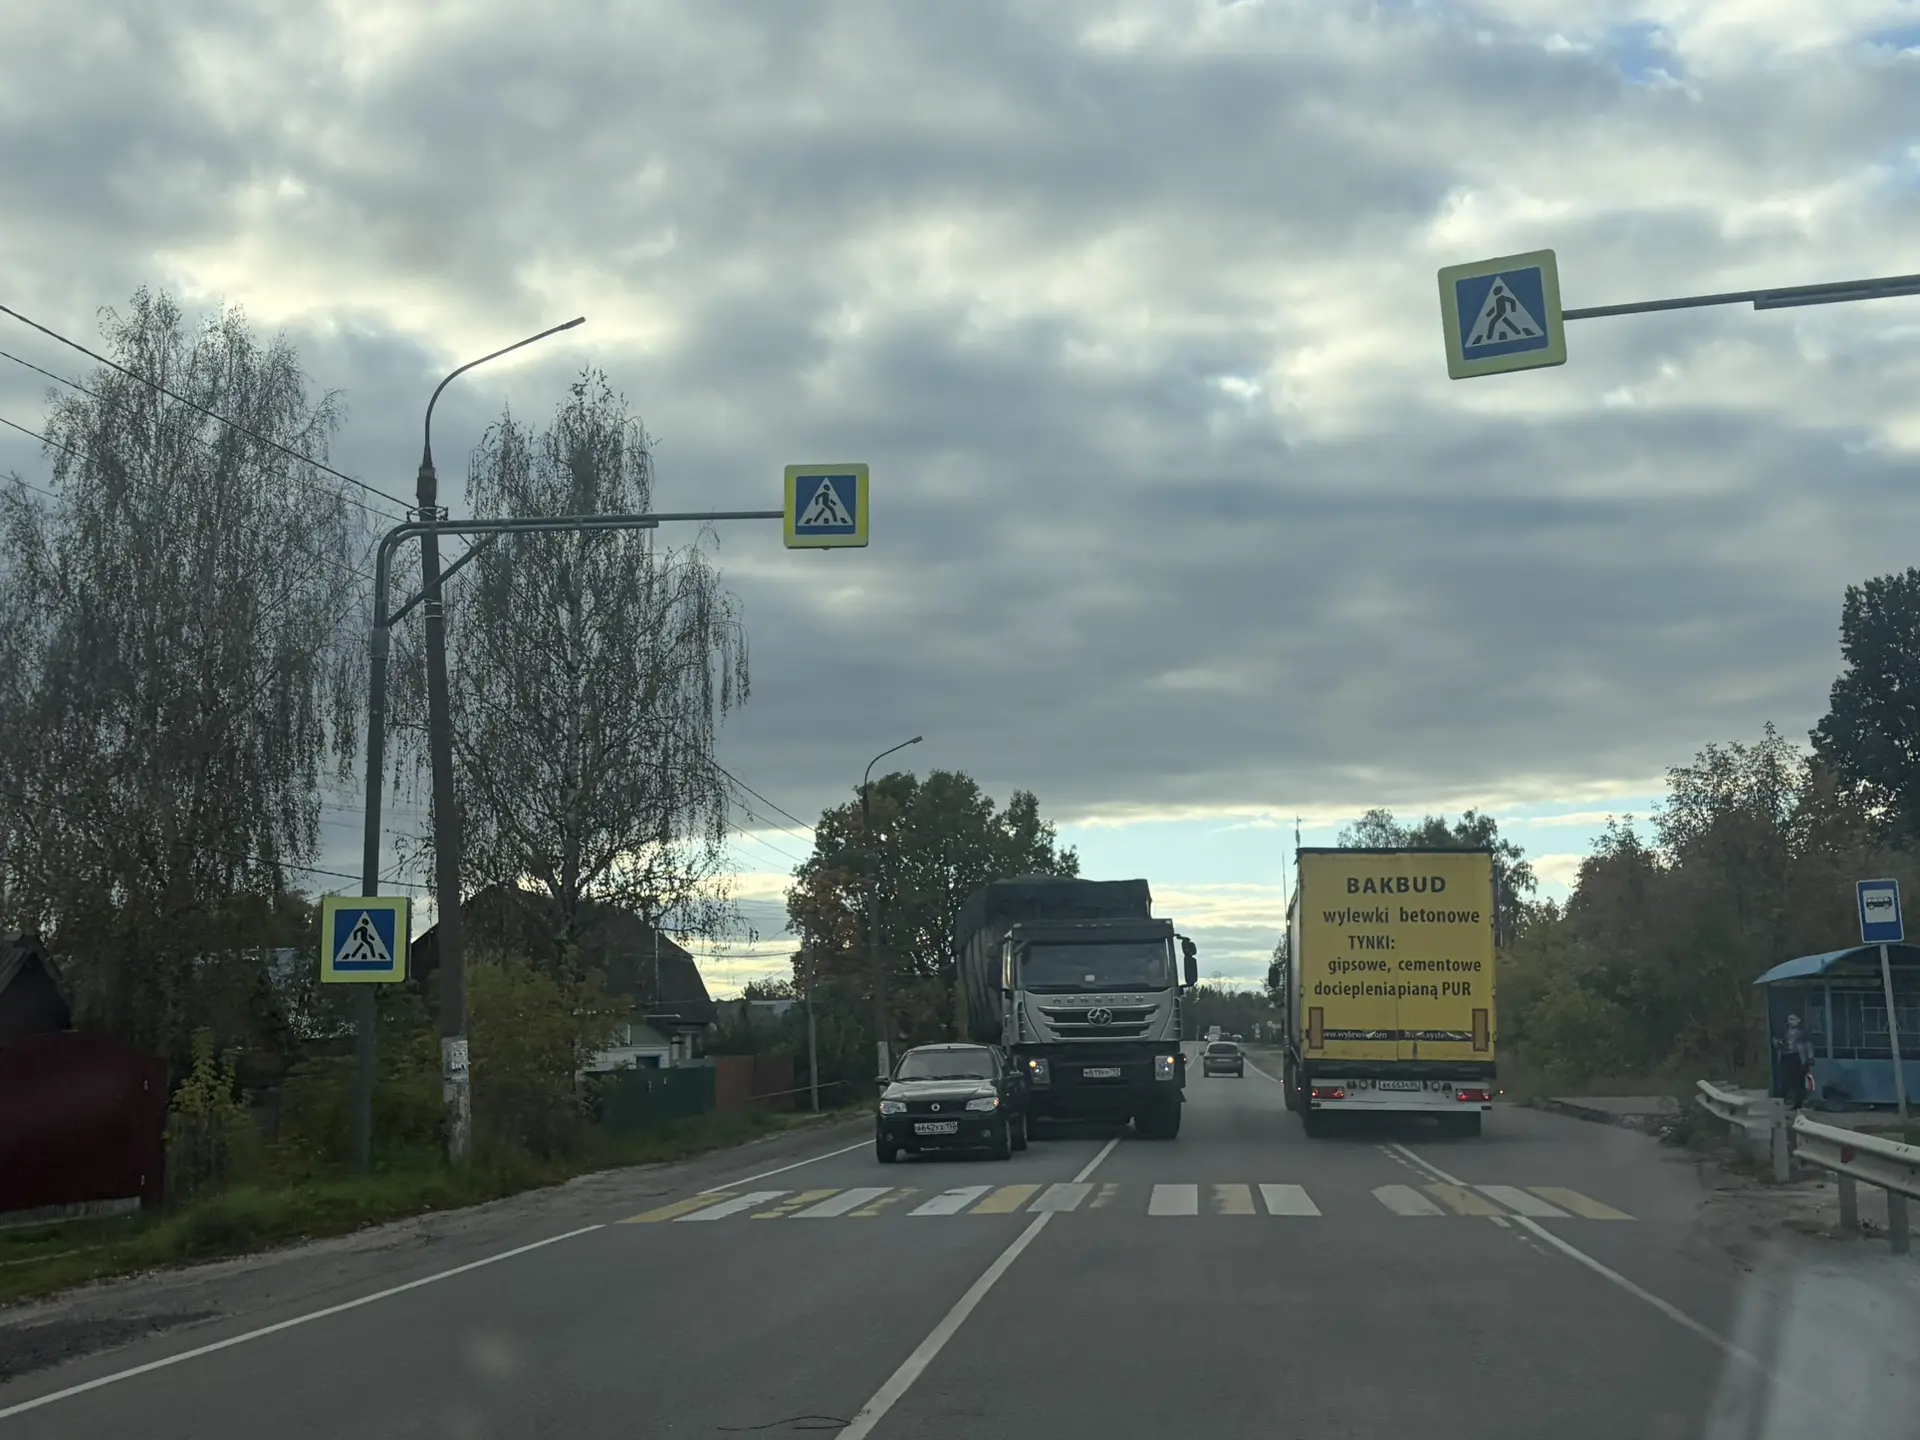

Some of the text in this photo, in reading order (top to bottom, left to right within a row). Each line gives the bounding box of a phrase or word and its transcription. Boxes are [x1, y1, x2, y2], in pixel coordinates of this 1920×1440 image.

[1346, 876, 1446, 894] BAKBUD
[1322, 906, 1480, 926] wylewki betonowe
[1347, 935, 1395, 950] TYNKI:
[1327, 957, 1482, 974] gipsowe, cementowe
[1442, 982, 1472, 996] PUR
